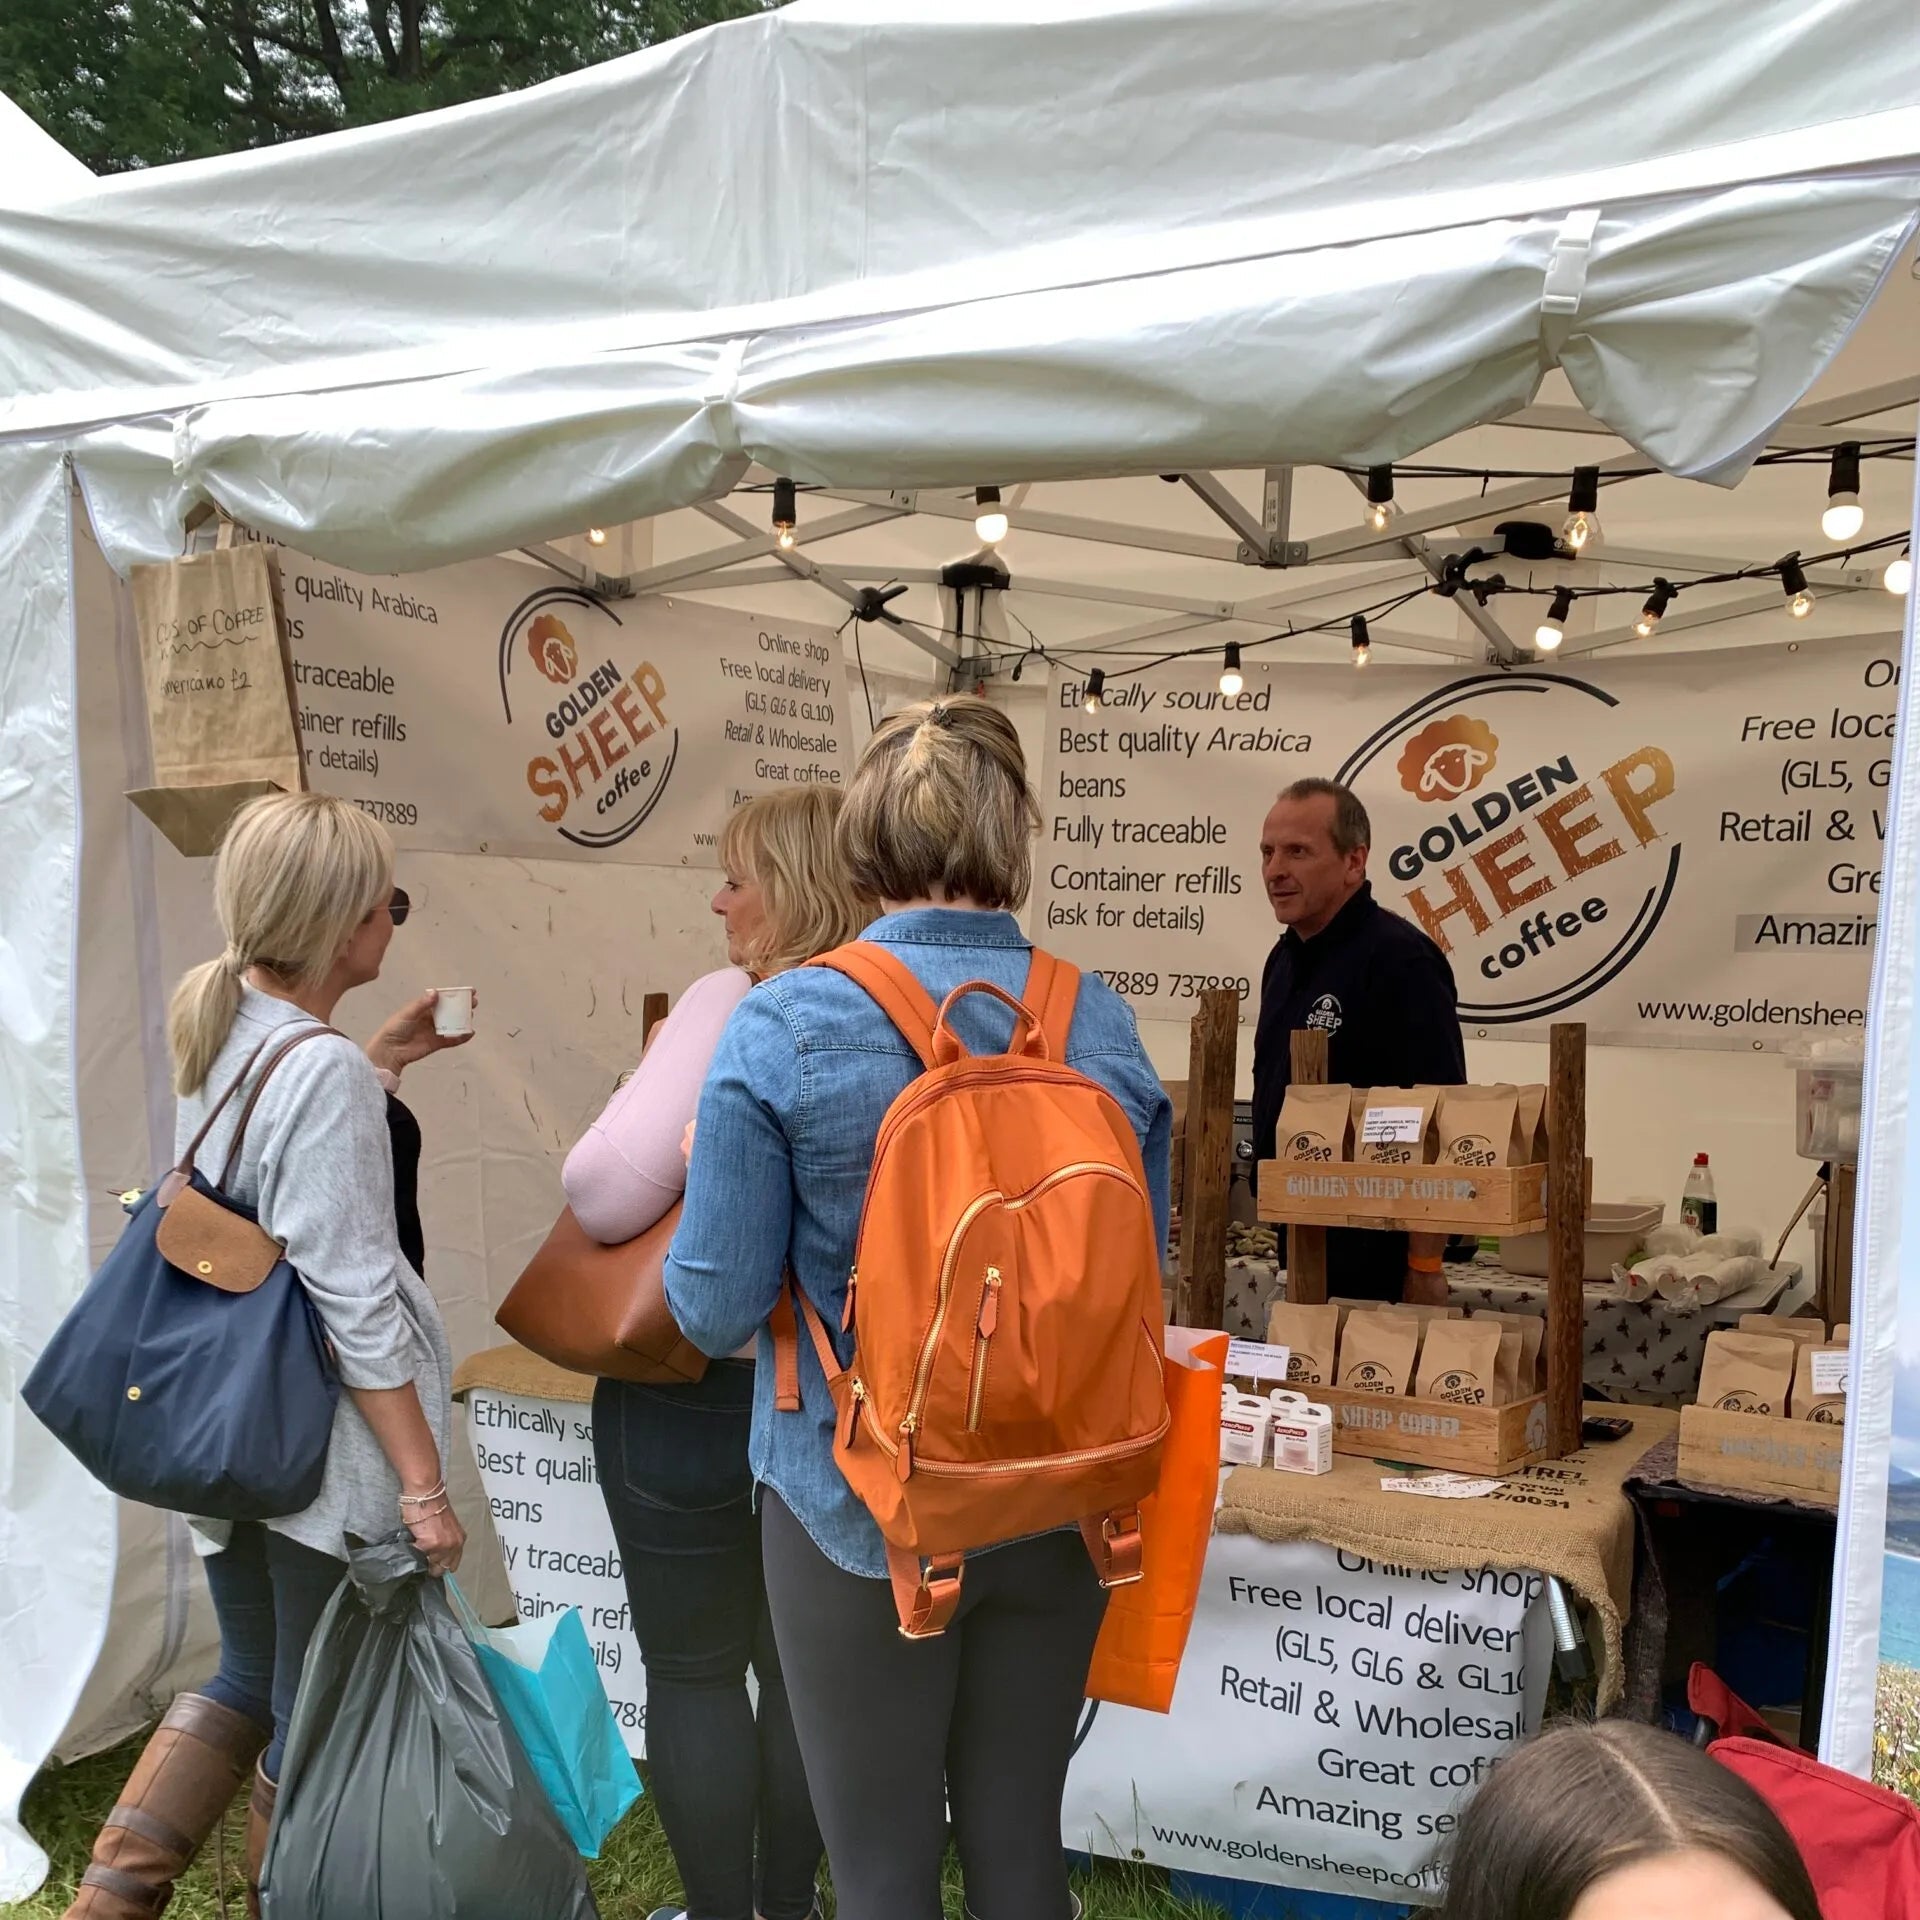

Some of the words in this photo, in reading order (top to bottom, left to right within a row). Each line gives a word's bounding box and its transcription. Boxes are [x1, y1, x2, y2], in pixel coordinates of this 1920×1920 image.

[295, 574, 363, 611] quality
[371, 588, 438, 624] Arabica
[187, 615, 207, 634] OF
[758, 632, 800, 656] Online
[804, 638, 829, 663] shop
[231, 668, 252, 691] £2
[293, 659, 394, 694] traceable
[720, 658, 752, 680] Free
[755, 661, 784, 686] local
[788, 667, 831, 697] delivery
[545, 658, 623, 739] GOLDEN
[745, 690, 767, 714] (GL5,
[770, 697, 786, 716] GL6
[788, 701, 798, 717] &
[801, 704, 834, 725] GL10)
[1163, 684, 1272, 712] sourced
[299, 706, 344, 734] ainer
[352, 713, 407, 742] refills
[725, 720, 753, 744] Retail
[755, 727, 764, 745] &
[768, 732, 837, 753] Wholesale
[1059, 728, 1108, 753] Best
[1118, 724, 1200, 758] quality
[1207, 727, 1312, 752] Arabica
[1741, 715, 1816, 742] Free
[1831, 708, 1897, 738] loca
[526, 660, 667, 823] SHEEP
[320, 745, 378, 778] details)
[755, 759, 790, 782] Great
[793, 767, 841, 784] coffee
[1782, 757, 1854, 795] (GL5,
[596, 759, 651, 815] coffee
[1059, 771, 1126, 798] beans
[1053, 815, 1104, 848] Fully
[1112, 816, 1227, 843] traceable
[1389, 755, 1579, 881] GOLDEN
[1720, 809, 1812, 842] Retail
[1826, 809, 1855, 841] &
[1402, 746, 1676, 955] HEEP
[1050, 864, 1166, 892] Container
[1176, 866, 1242, 895] refills
[1828, 863, 1884, 894] Gre
[1047, 901, 1088, 930] (ask
[1095, 903, 1125, 928] for
[1133, 905, 1204, 935] details)
[1480, 897, 1608, 979] coffee
[1306, 1013, 1342, 1029] SHEEP
[1293, 1146, 1319, 1161] GOLDEN
[1370, 1148, 1399, 1161] GOLDEN
[1453, 1149, 1482, 1165] GOLDEN
[1286, 1175, 1348, 1198] GOLDEN
[1354, 1176, 1405, 1199] SHEEP
[1287, 1370, 1310, 1379] OLDEN
[1354, 1380, 1384, 1389] GOLDEN
[1440, 1387, 1471, 1400] GOLDEN
[474, 1399, 565, 1442] Ethically
[1342, 1405, 1393, 1431] SHEEP
[477, 1443, 526, 1475] Best
[536, 1455, 601, 1485] qualit
[490, 1497, 543, 1523] eans
[527, 1543, 623, 1580] traceab
[1461, 1567, 1543, 1608] shop
[1229, 1576, 1302, 1610] Free
[1316, 1585, 1392, 1630] local
[1405, 1604, 1522, 1652] deliver
[1276, 1625, 1339, 1675] (GL5,
[1352, 1647, 1403, 1686] GL6
[1416, 1662, 1444, 1689] &
[1221, 1665, 1301, 1716] Retail
[1314, 1690, 1340, 1727] &
[1354, 1699, 1525, 1741] Wholesal
[1317, 1748, 1415, 1787] Great
[1256, 1786, 1403, 1840] Amazing
